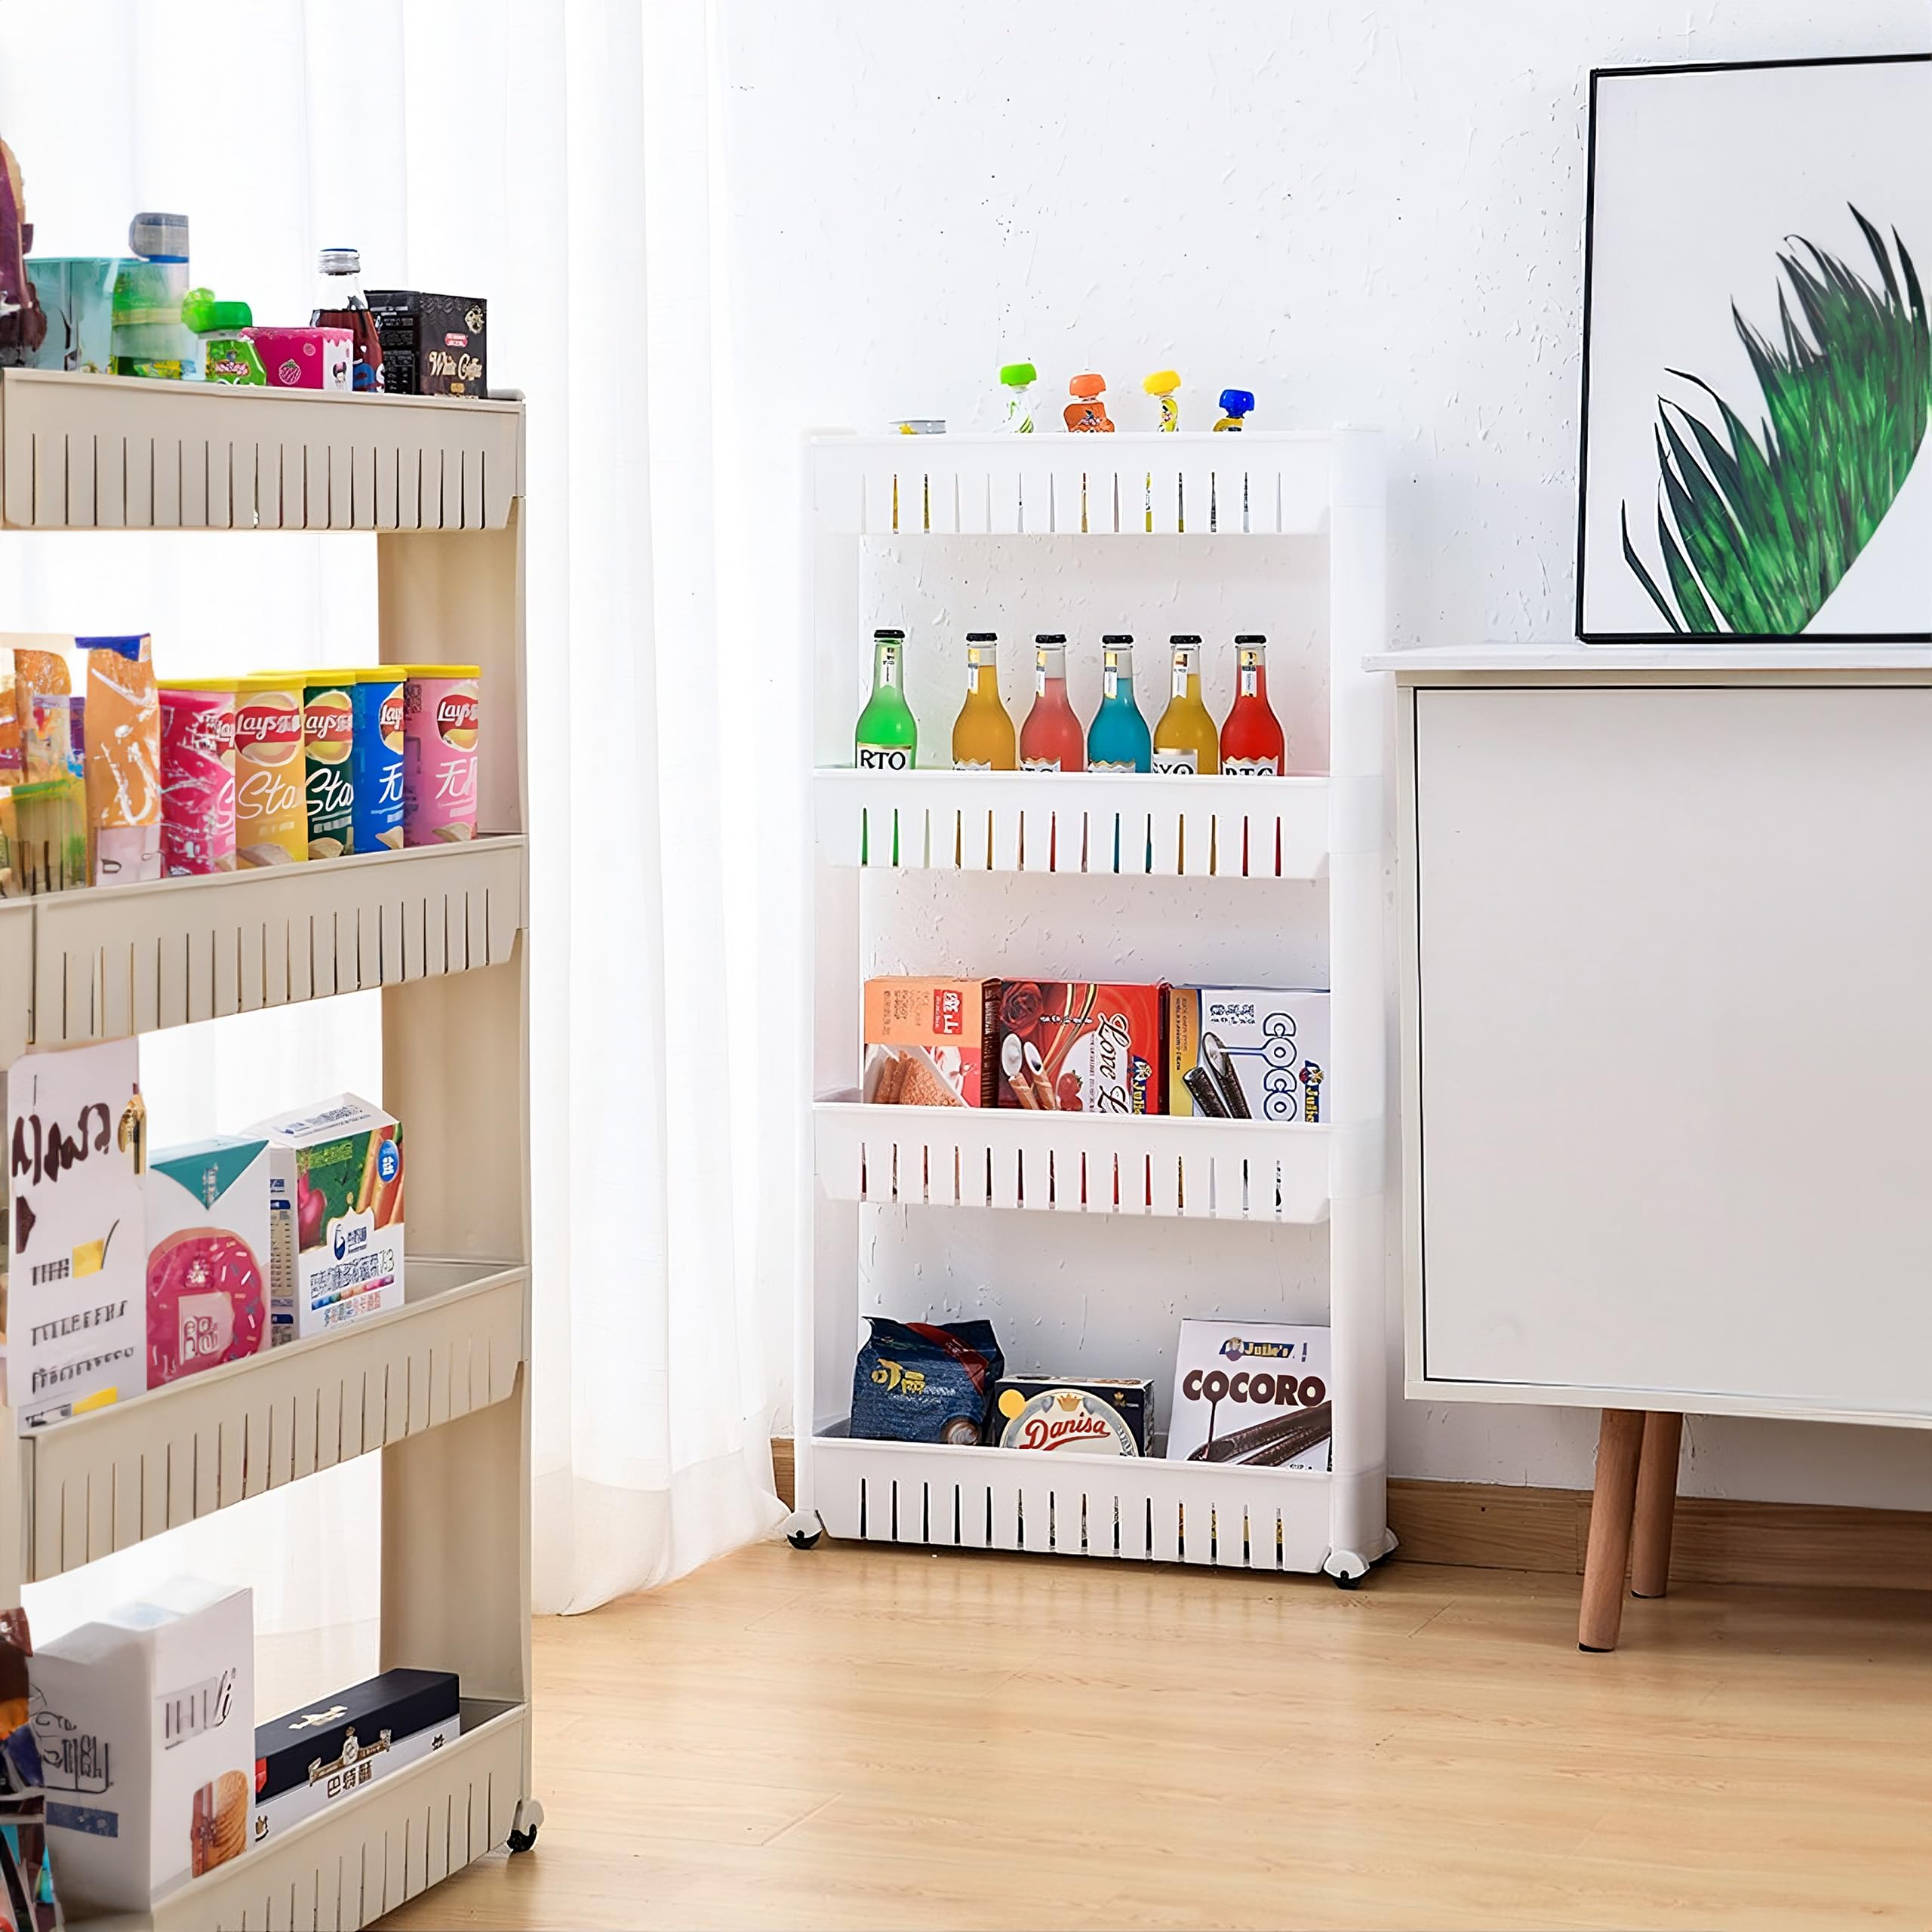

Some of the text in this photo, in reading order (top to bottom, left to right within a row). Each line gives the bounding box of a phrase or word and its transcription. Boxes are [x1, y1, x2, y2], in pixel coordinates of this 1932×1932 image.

[1097, 1014, 1131, 1081] Love
[1182, 1369, 1327, 1407] COCORO
[1018, 1411, 1112, 1450] Danisa
